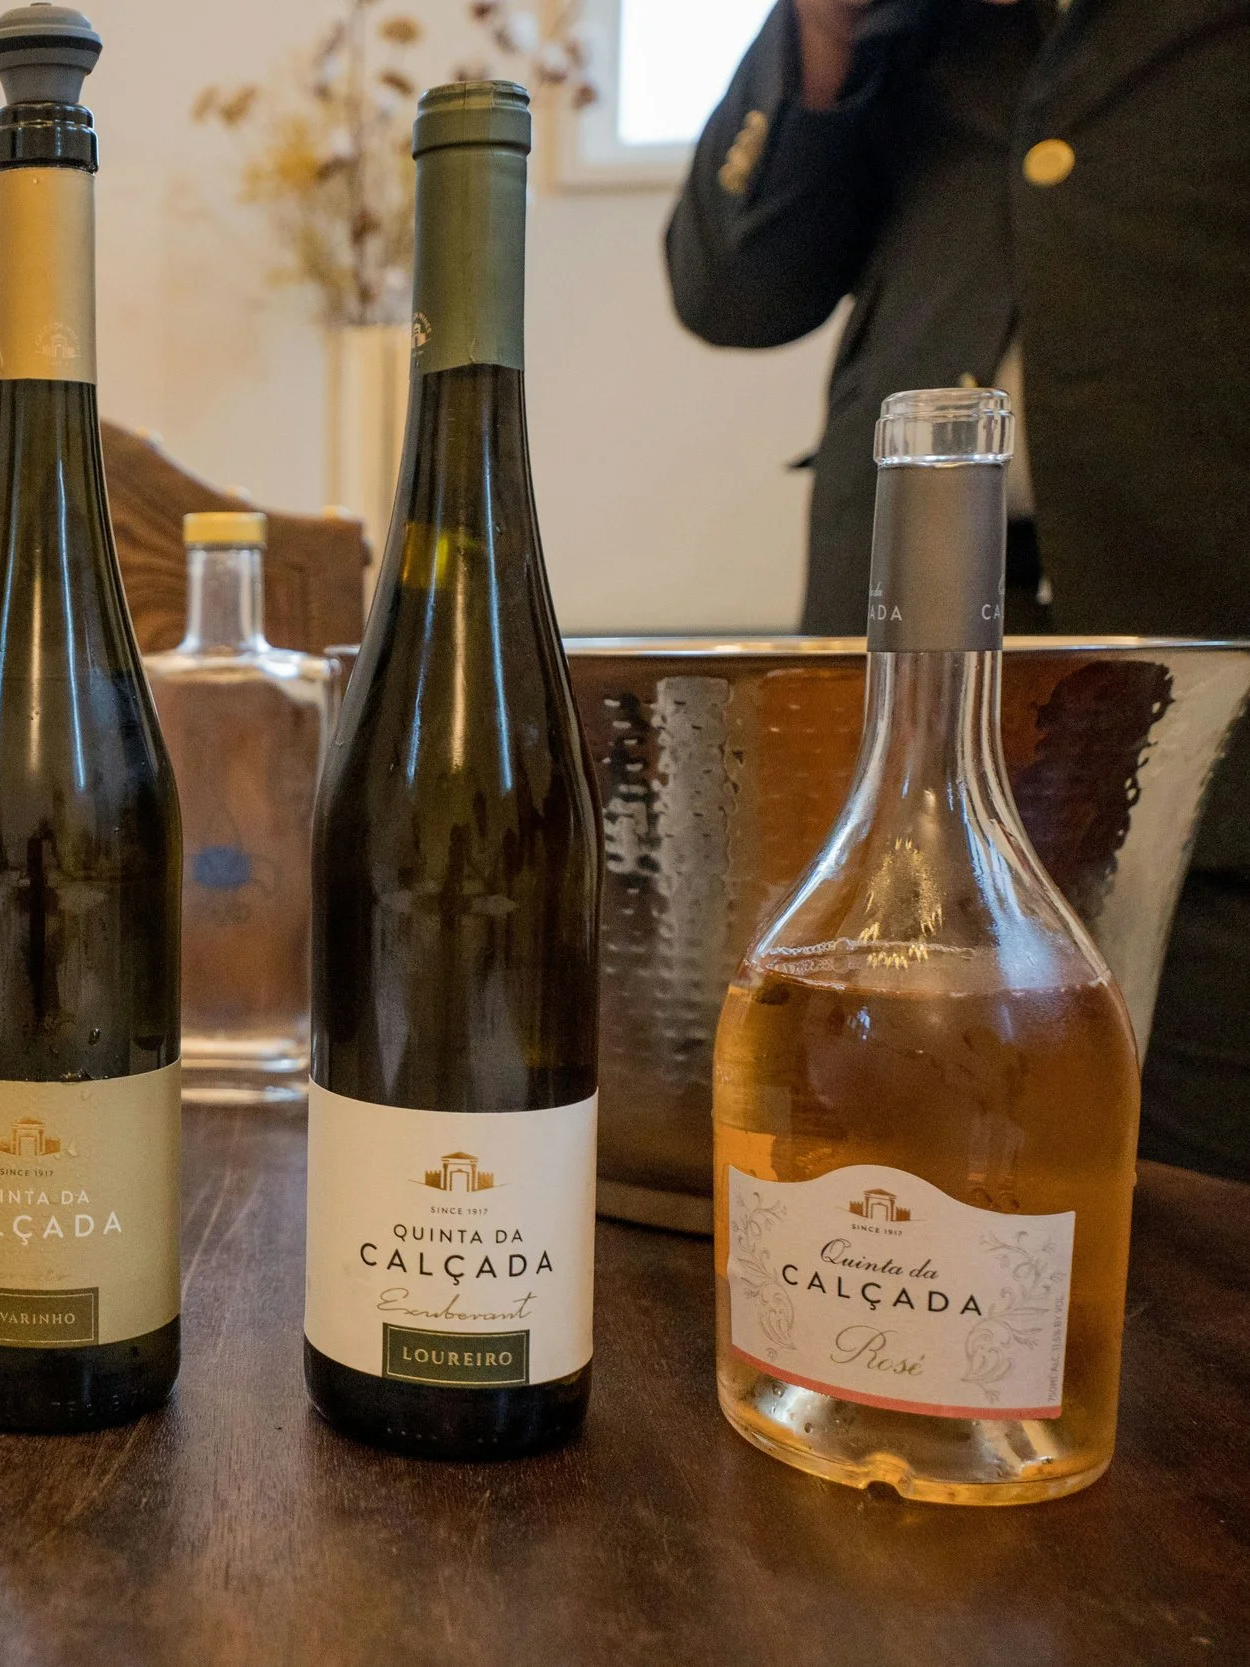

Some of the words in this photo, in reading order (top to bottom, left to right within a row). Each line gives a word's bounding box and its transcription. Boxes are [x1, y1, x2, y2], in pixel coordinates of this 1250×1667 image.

[0, 1168, 29, 1177] SINCE
[61, 1190, 89, 1204] DA
[431, 1206, 462, 1215] SINCE
[394, 1224, 482, 1243] QUINTA
[496, 1229, 522, 1243] DA
[852, 1224, 879, 1233] SINCE
[885, 1228, 902, 1236] 1917
[360, 1243, 553, 1285] CALÇADA
[821, 1238, 903, 1275] Quinta
[910, 1259, 939, 1279] da
[782, 1264, 982, 1316] CALÇADA
[377, 1288, 537, 1320] Exuberant
[403, 1347, 512, 1366] LOUREIRO
[831, 1325, 925, 1375] Rosé
